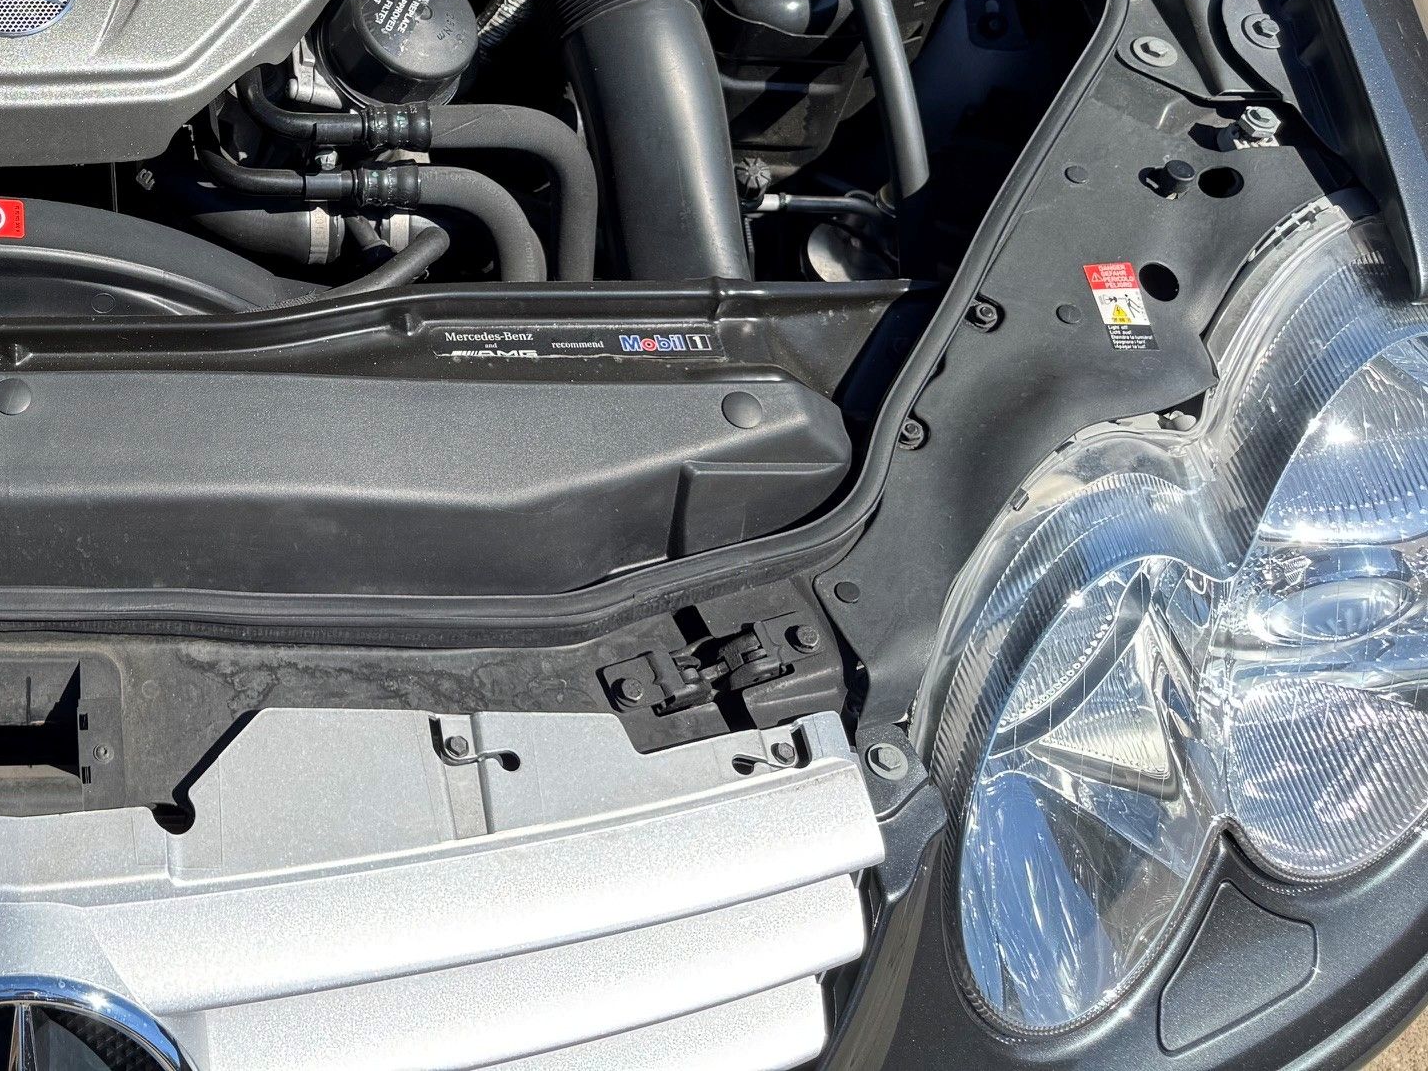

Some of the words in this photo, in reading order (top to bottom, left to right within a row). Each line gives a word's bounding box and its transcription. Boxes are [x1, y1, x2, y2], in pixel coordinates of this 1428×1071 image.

[398, 0, 420, 33] REPLACE
[445, 331, 534, 341] Mercedes-Benz
[619, 334, 685, 352] Mobil
[551, 341, 604, 349] recommend
